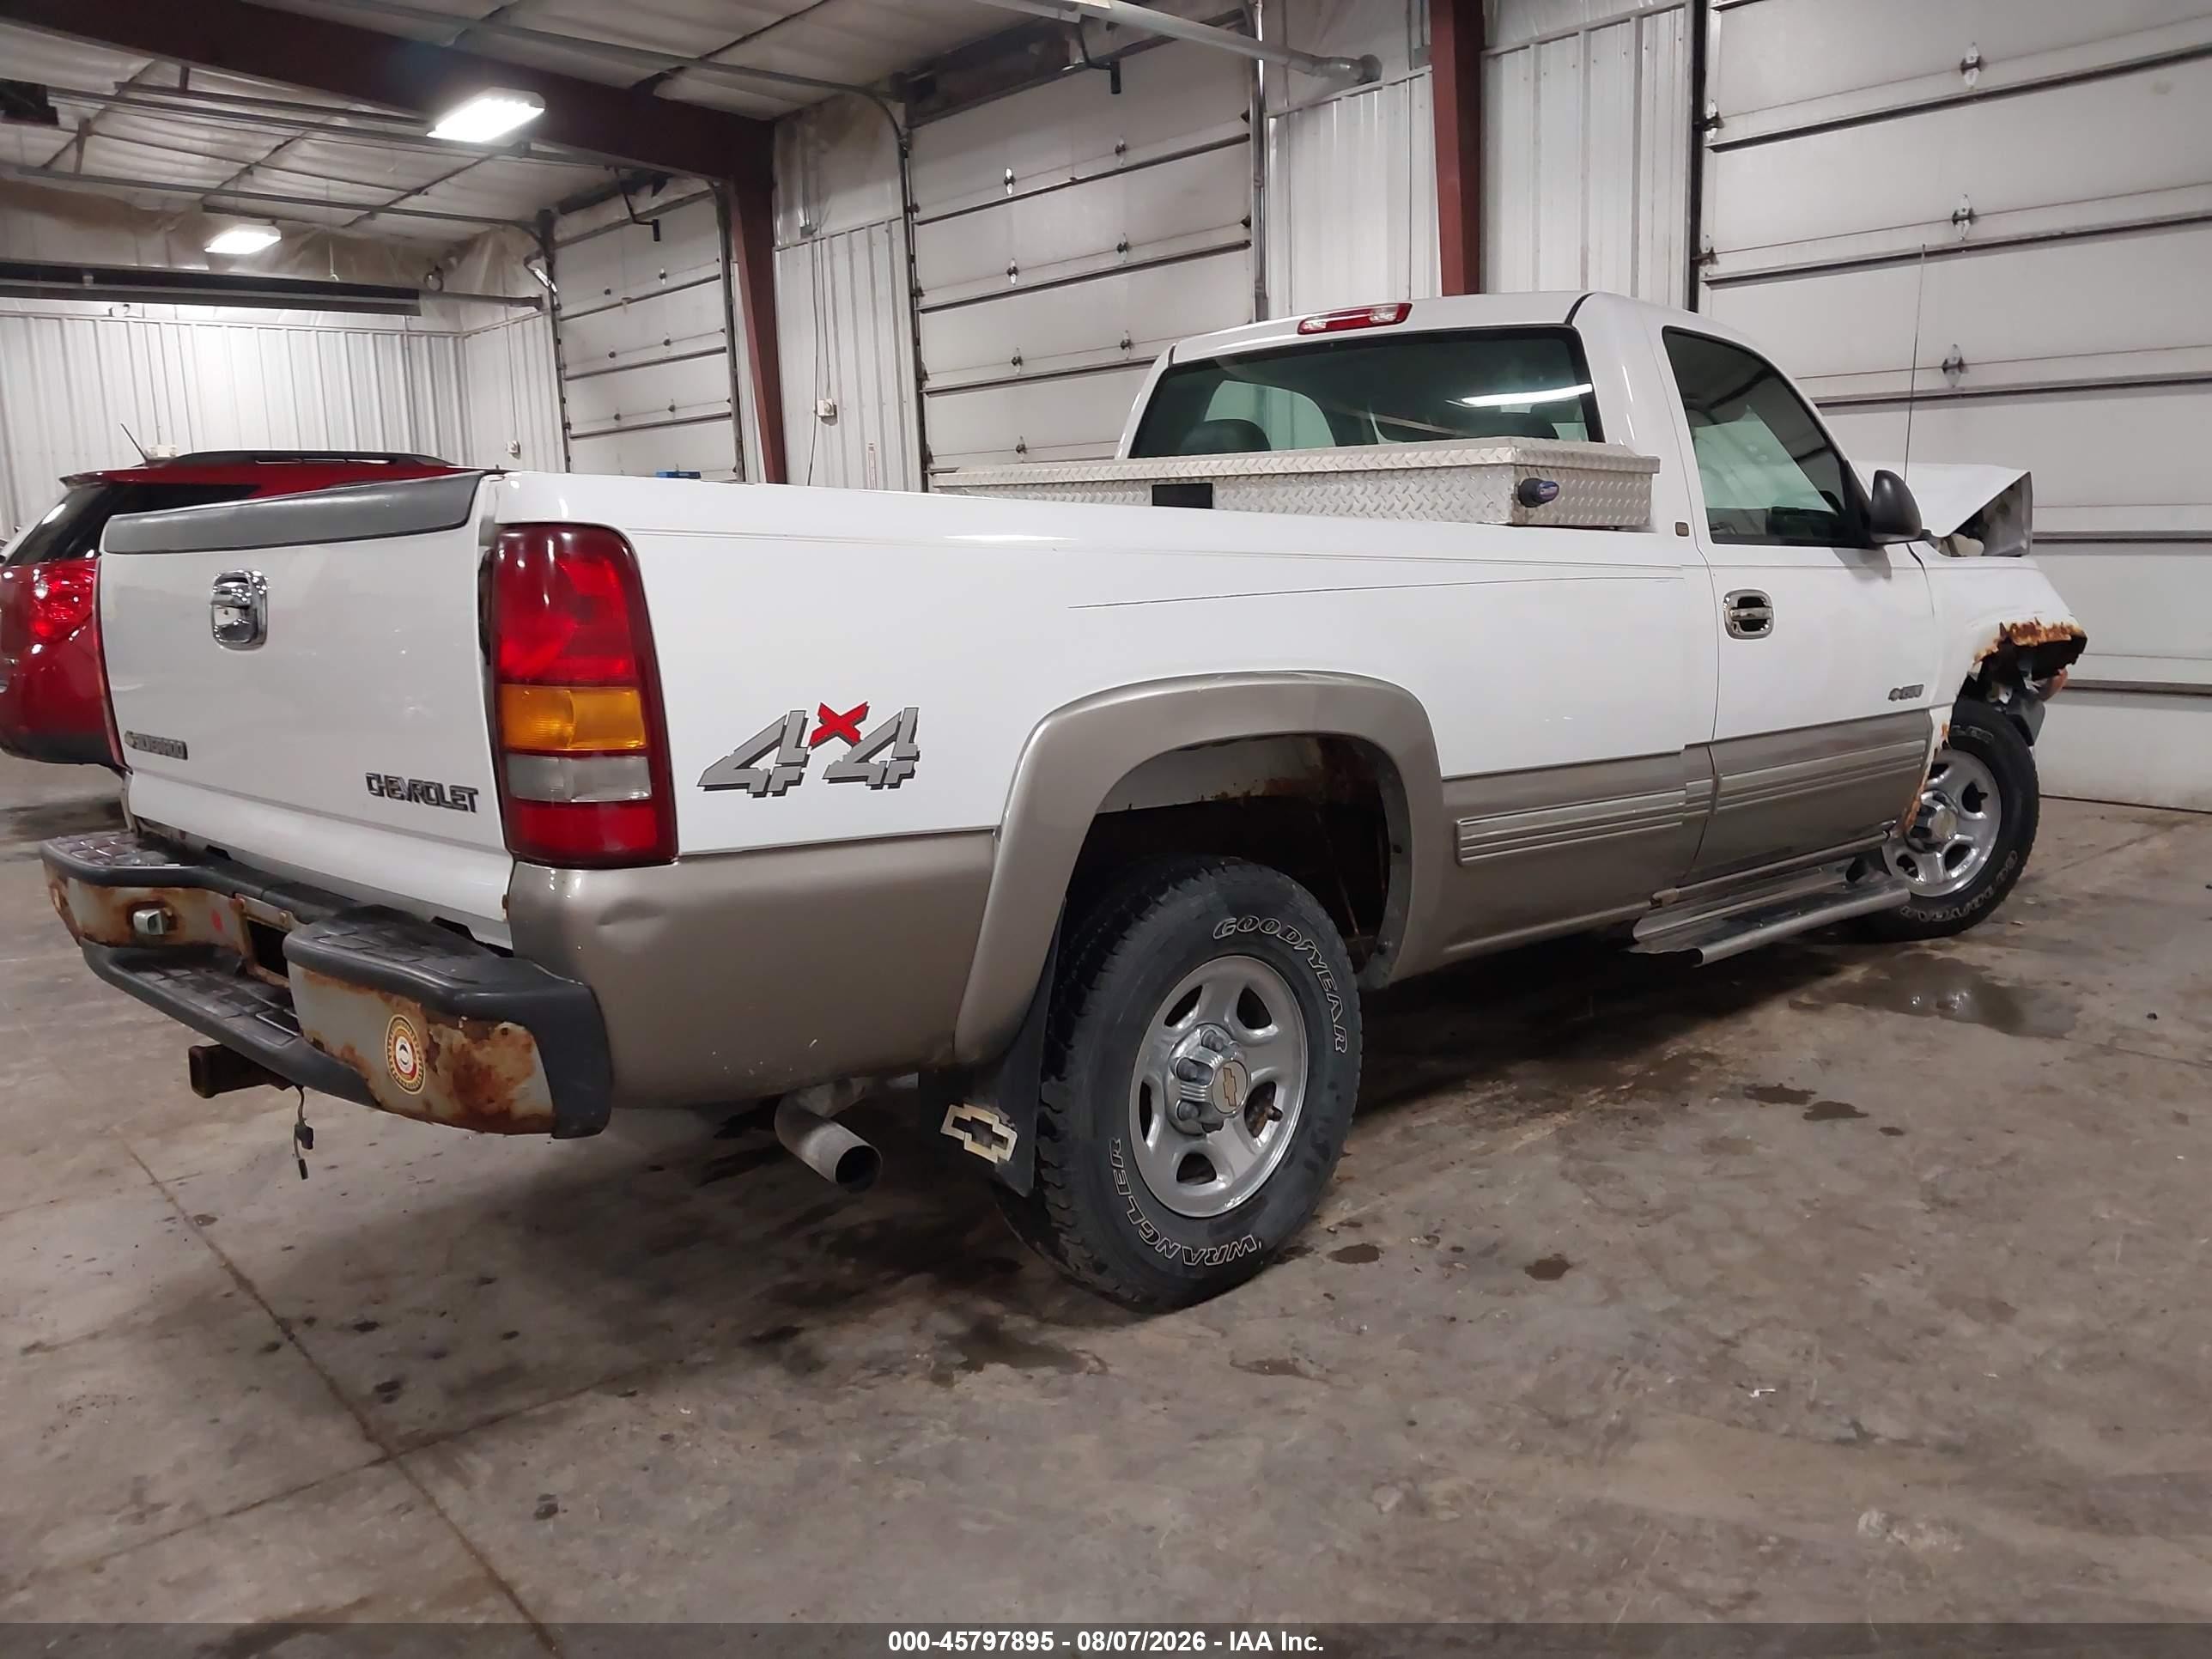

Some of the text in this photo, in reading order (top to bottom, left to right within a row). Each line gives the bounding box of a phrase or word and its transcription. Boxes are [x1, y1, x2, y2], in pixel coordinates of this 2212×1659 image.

[365, 772, 479, 813] CHEVROLET
[1212, 915, 1349, 1054] GOODYEAR
[1109, 1138, 1258, 1267] WRANGLER
